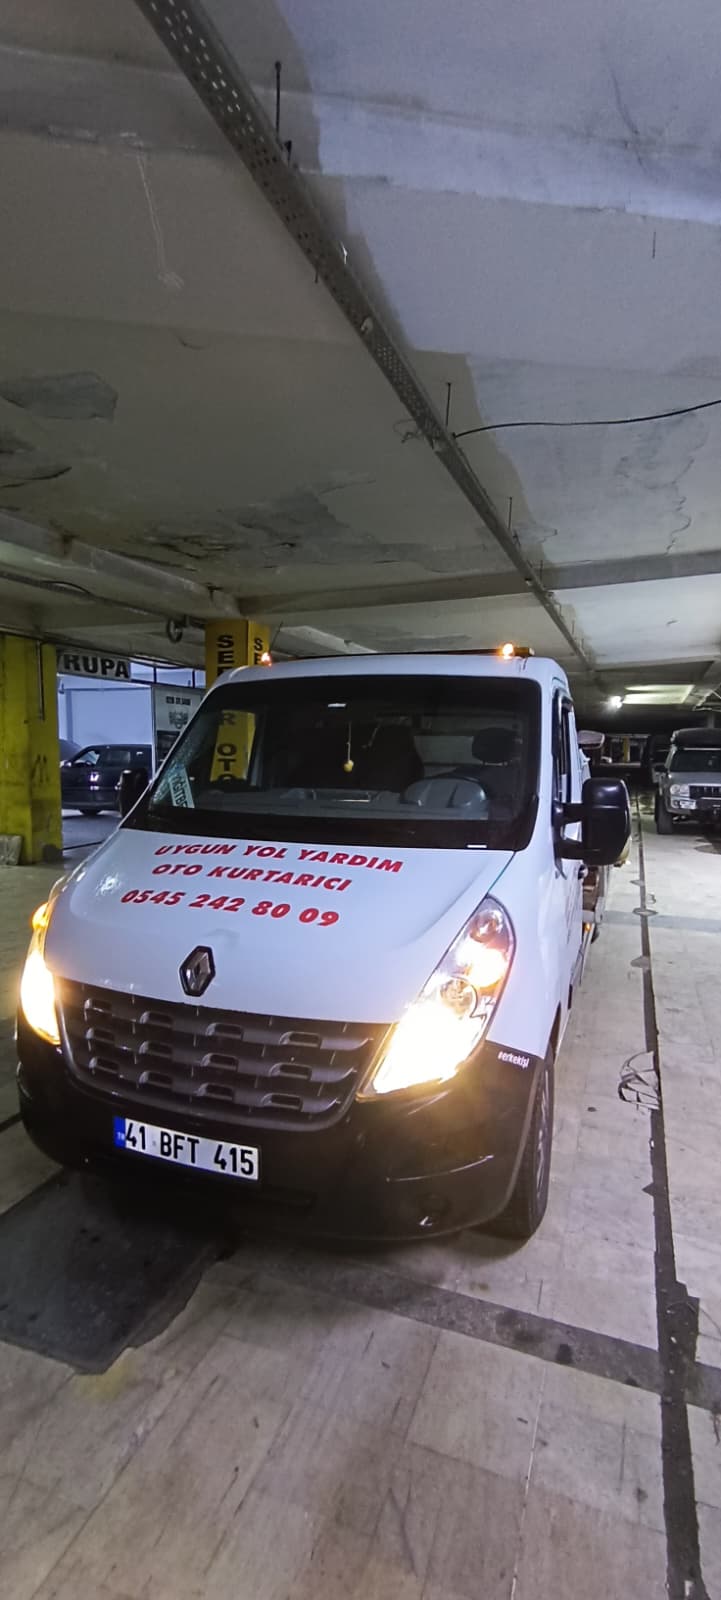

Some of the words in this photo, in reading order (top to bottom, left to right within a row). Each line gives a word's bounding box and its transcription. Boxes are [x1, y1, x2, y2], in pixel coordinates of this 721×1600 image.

[57, 654, 129, 678] RUPA
[154, 844, 237, 856] UYGUN
[243, 845, 288, 859] YOL
[298, 849, 403, 873] YARDIM
[152, 864, 203, 876] OTO
[207, 866, 352, 891] KURTARICI
[121, 889, 186, 906] 0545
[188, 893, 245, 912] 242
[252, 901, 291, 918] 80
[299, 908, 340, 926] 09
[126, 1122, 146, 1150] 41
[160, 1131, 199, 1164] BFT
[213, 1144, 254, 1176] 415
